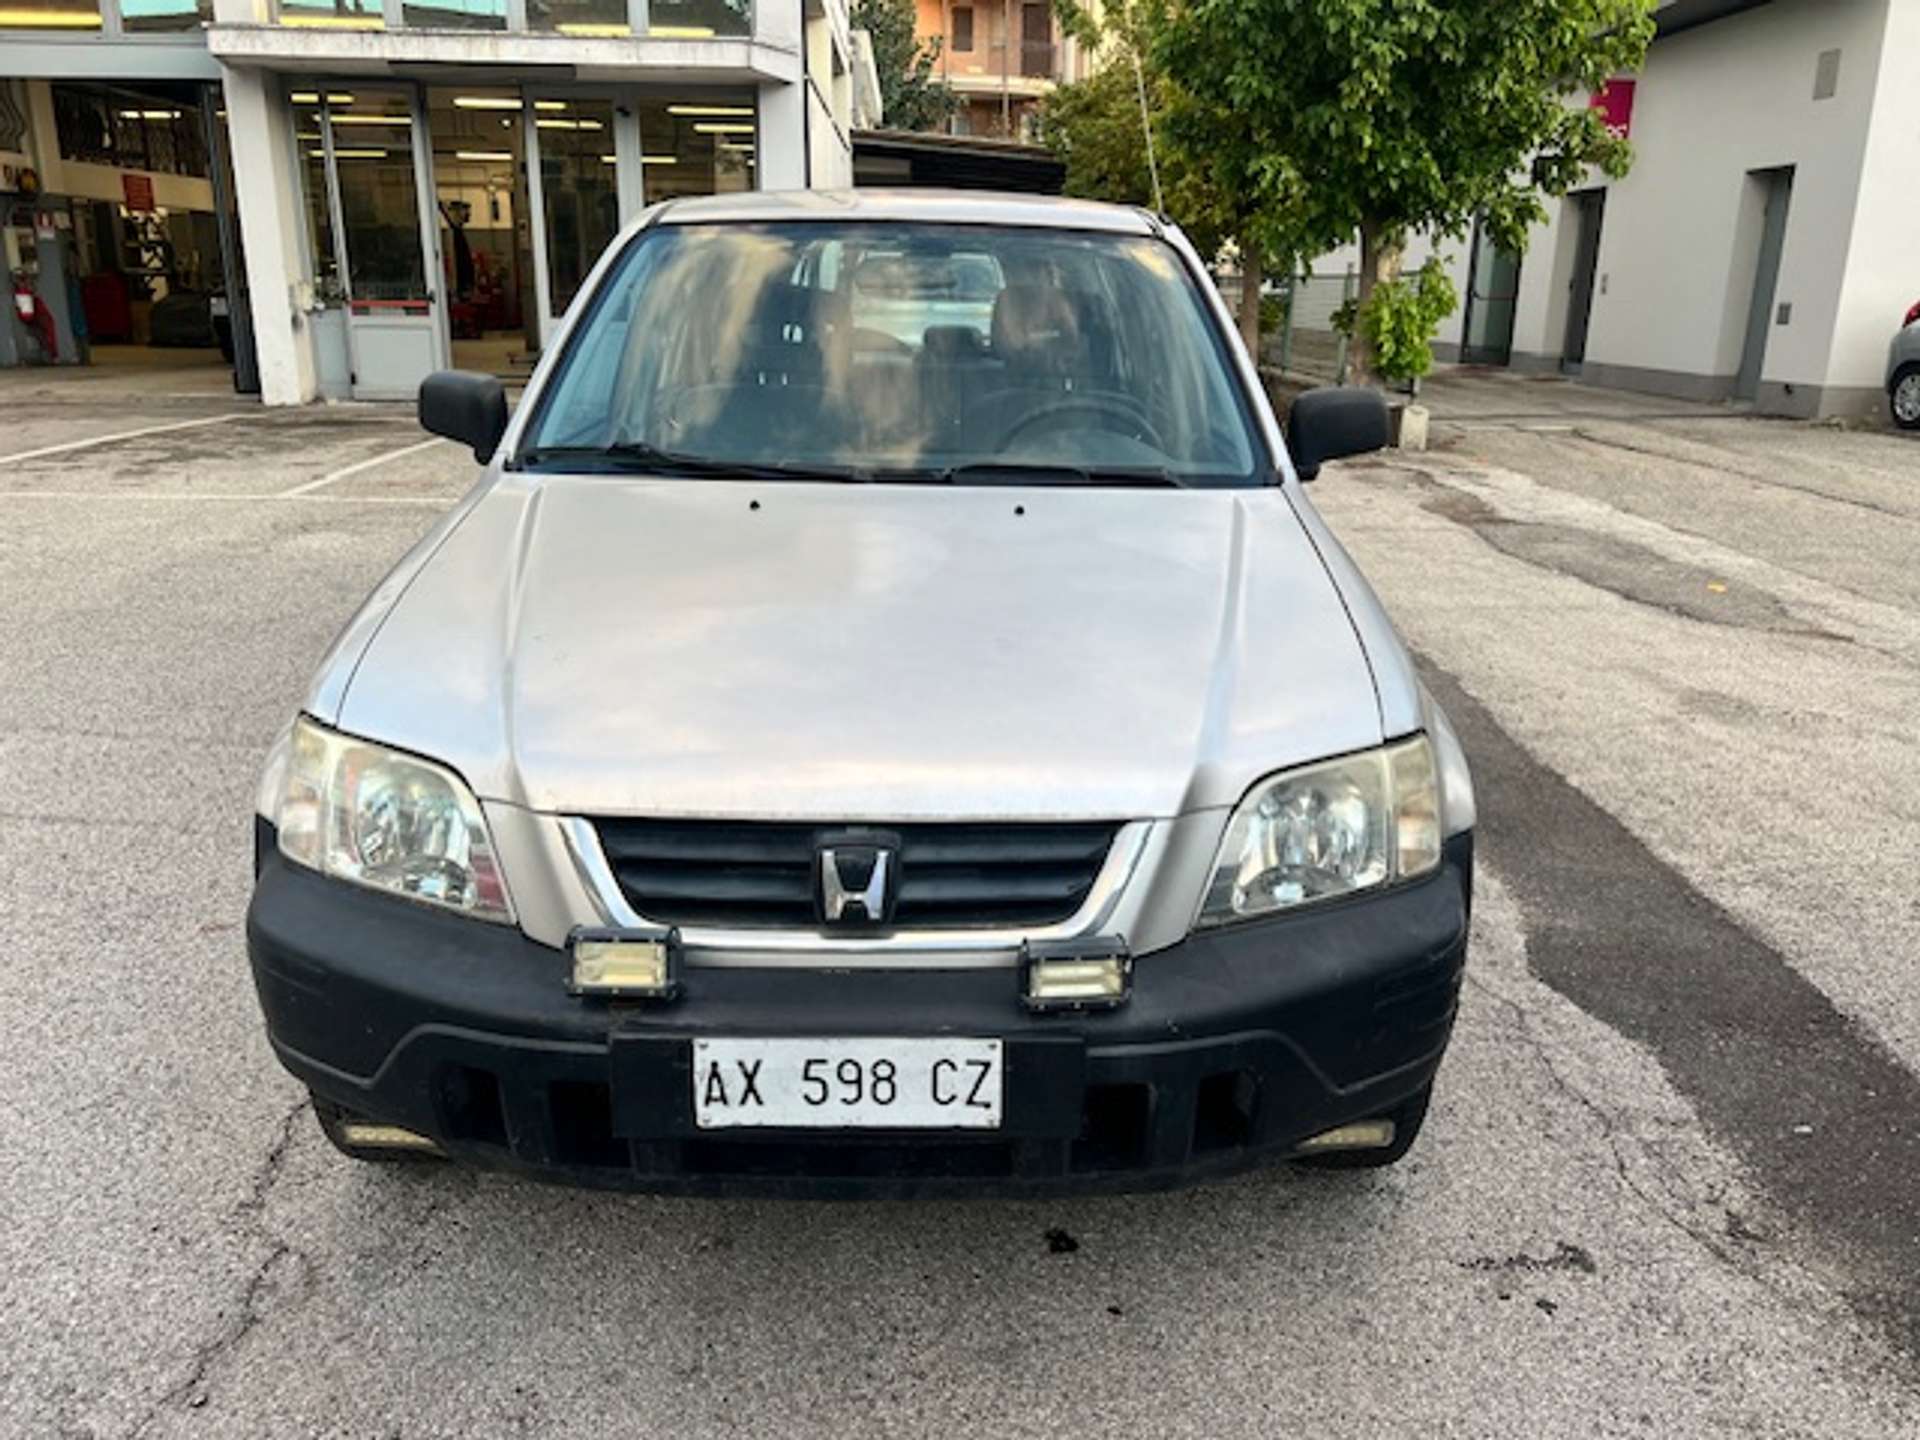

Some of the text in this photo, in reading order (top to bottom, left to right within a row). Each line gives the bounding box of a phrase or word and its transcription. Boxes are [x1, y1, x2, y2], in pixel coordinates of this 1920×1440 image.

[704, 1058, 992, 1109] AX 598 CZ
